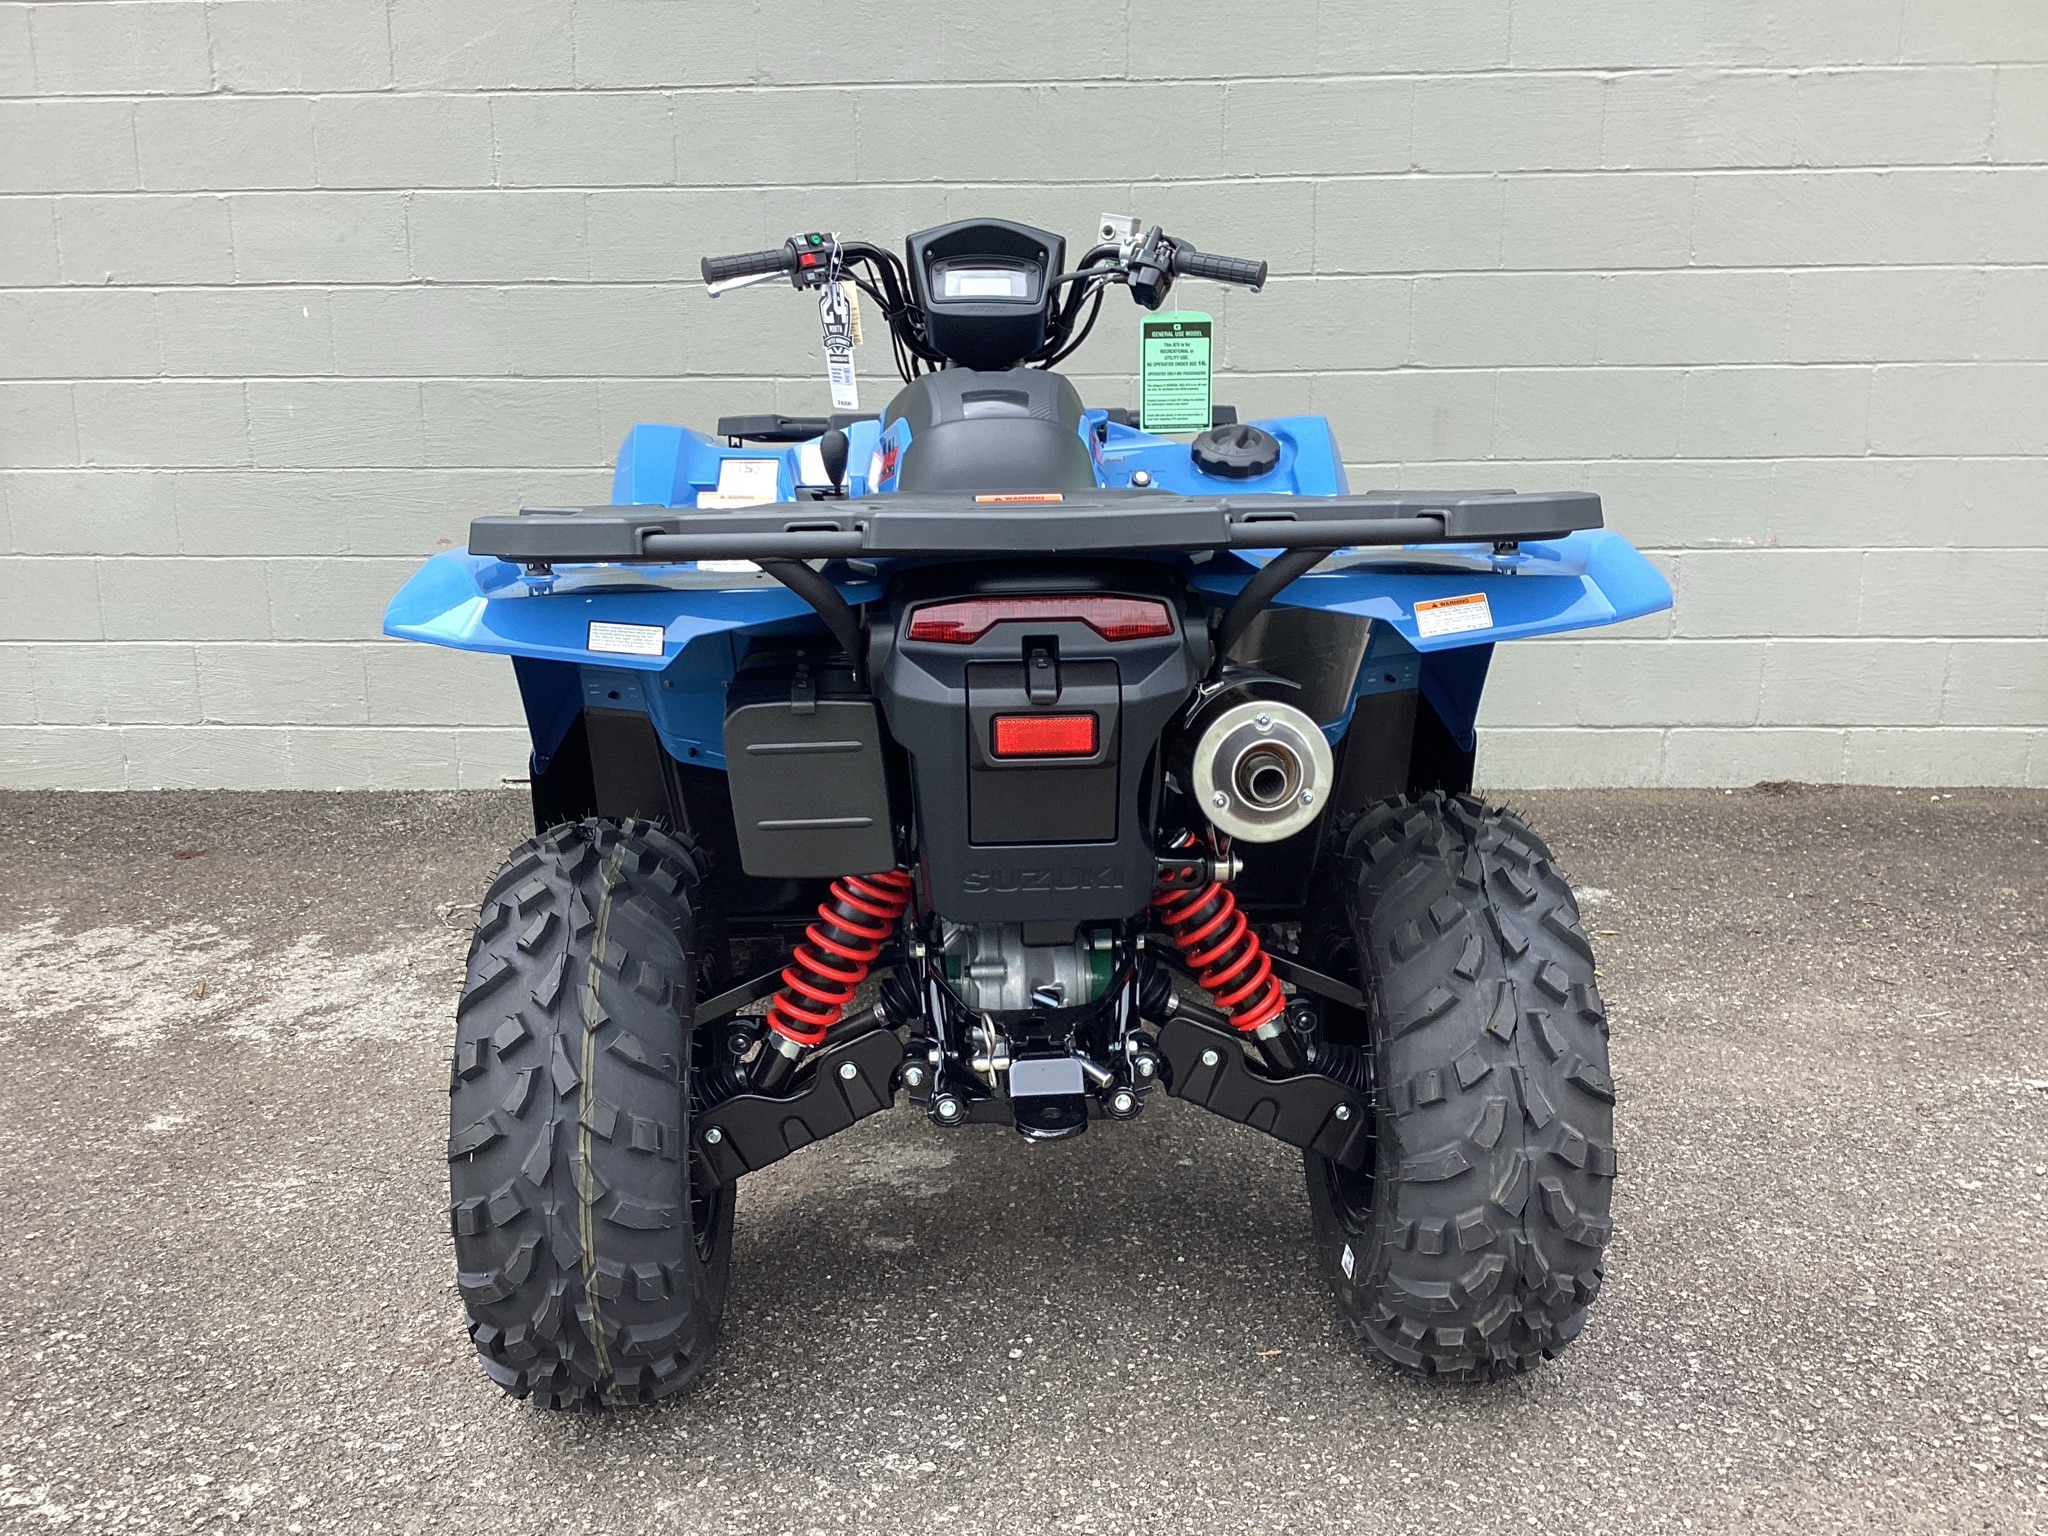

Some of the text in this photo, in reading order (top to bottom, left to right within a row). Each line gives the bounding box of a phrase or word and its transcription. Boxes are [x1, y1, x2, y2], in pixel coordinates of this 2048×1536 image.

[821, 283, 848, 324] 24
[1439, 598, 1470, 607] WARNING
[963, 867, 1124, 893] SUZUKI
